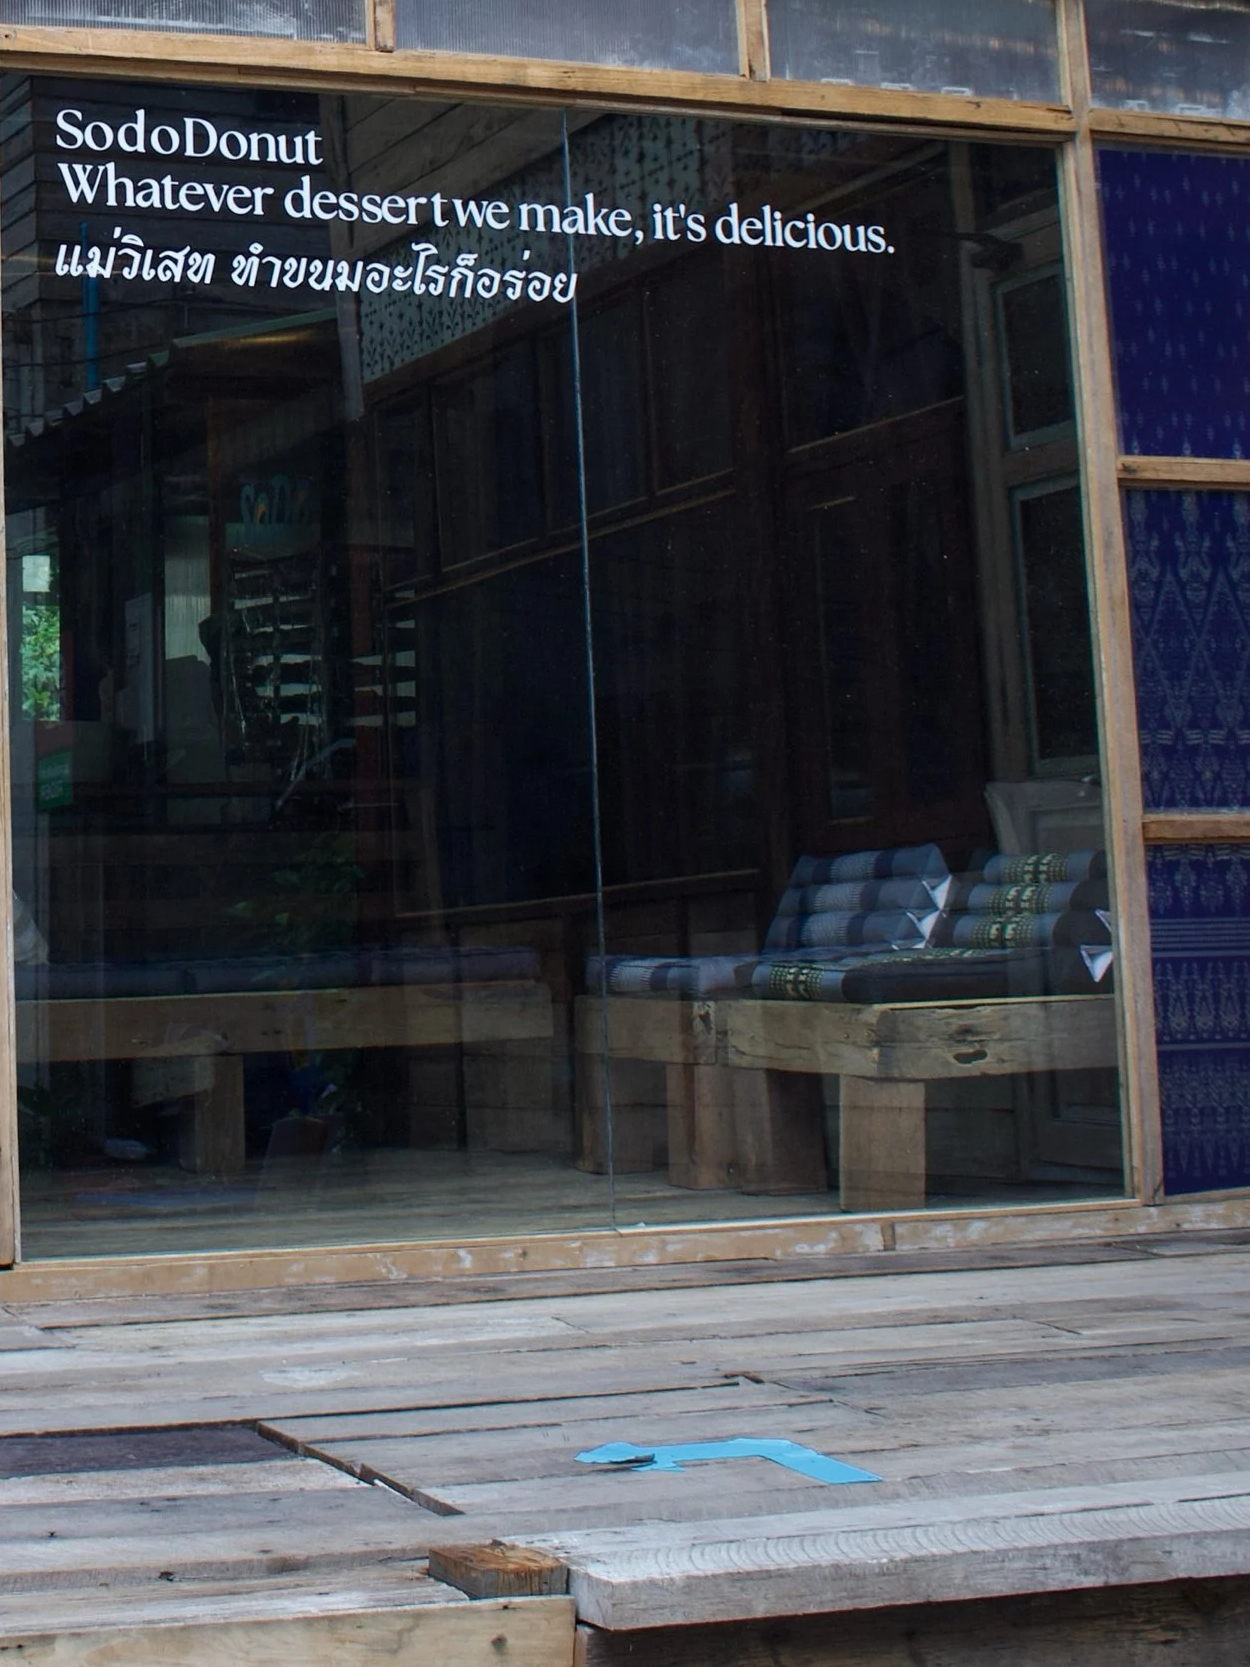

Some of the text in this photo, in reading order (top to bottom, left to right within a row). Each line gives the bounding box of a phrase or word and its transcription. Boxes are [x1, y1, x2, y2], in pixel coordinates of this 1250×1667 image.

[56, 108, 323, 165] SodoDonut
[57, 161, 896, 255] Whatever dessert we make, it's delicious.
[231, 241, 578, 304] ทำขนมอะไรก็อร่อย
